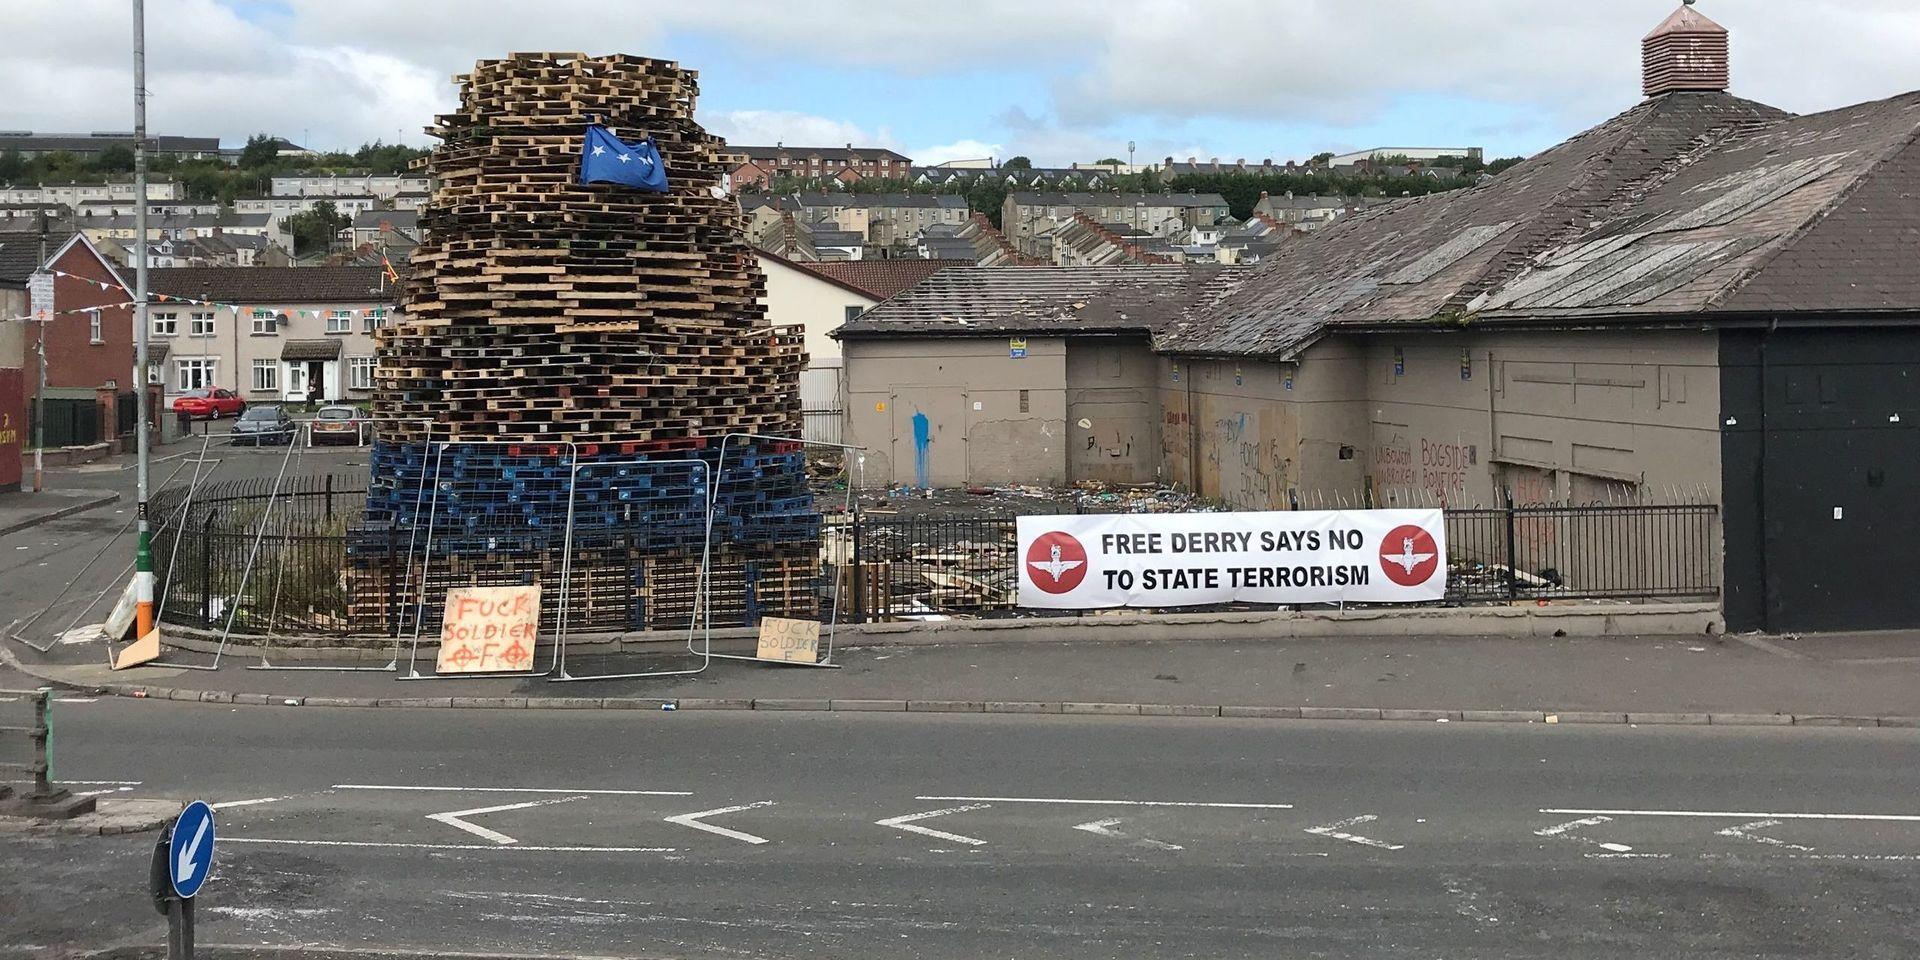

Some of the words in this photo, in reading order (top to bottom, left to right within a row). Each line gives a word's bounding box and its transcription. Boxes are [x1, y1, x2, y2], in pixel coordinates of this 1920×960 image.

[1421, 438, 1468, 470] BOGSIDE
[1423, 467, 1466, 491] BONFIRE
[1102, 533, 1162, 554] FREE
[1171, 531, 1252, 553] DERRY
[1260, 530, 1320, 552] SAYS
[1329, 529, 1363, 550] NO
[1102, 569, 1134, 590] TO
[1142, 568, 1219, 590] STATE
[1227, 565, 1369, 588] TERRORISM
[458, 592, 530, 620] FUCK
[443, 622, 535, 641] SOLDIER
[764, 619, 817, 636] FUCK
[480, 643, 500, 667] F
[760, 634, 818, 653] SOLDIER
